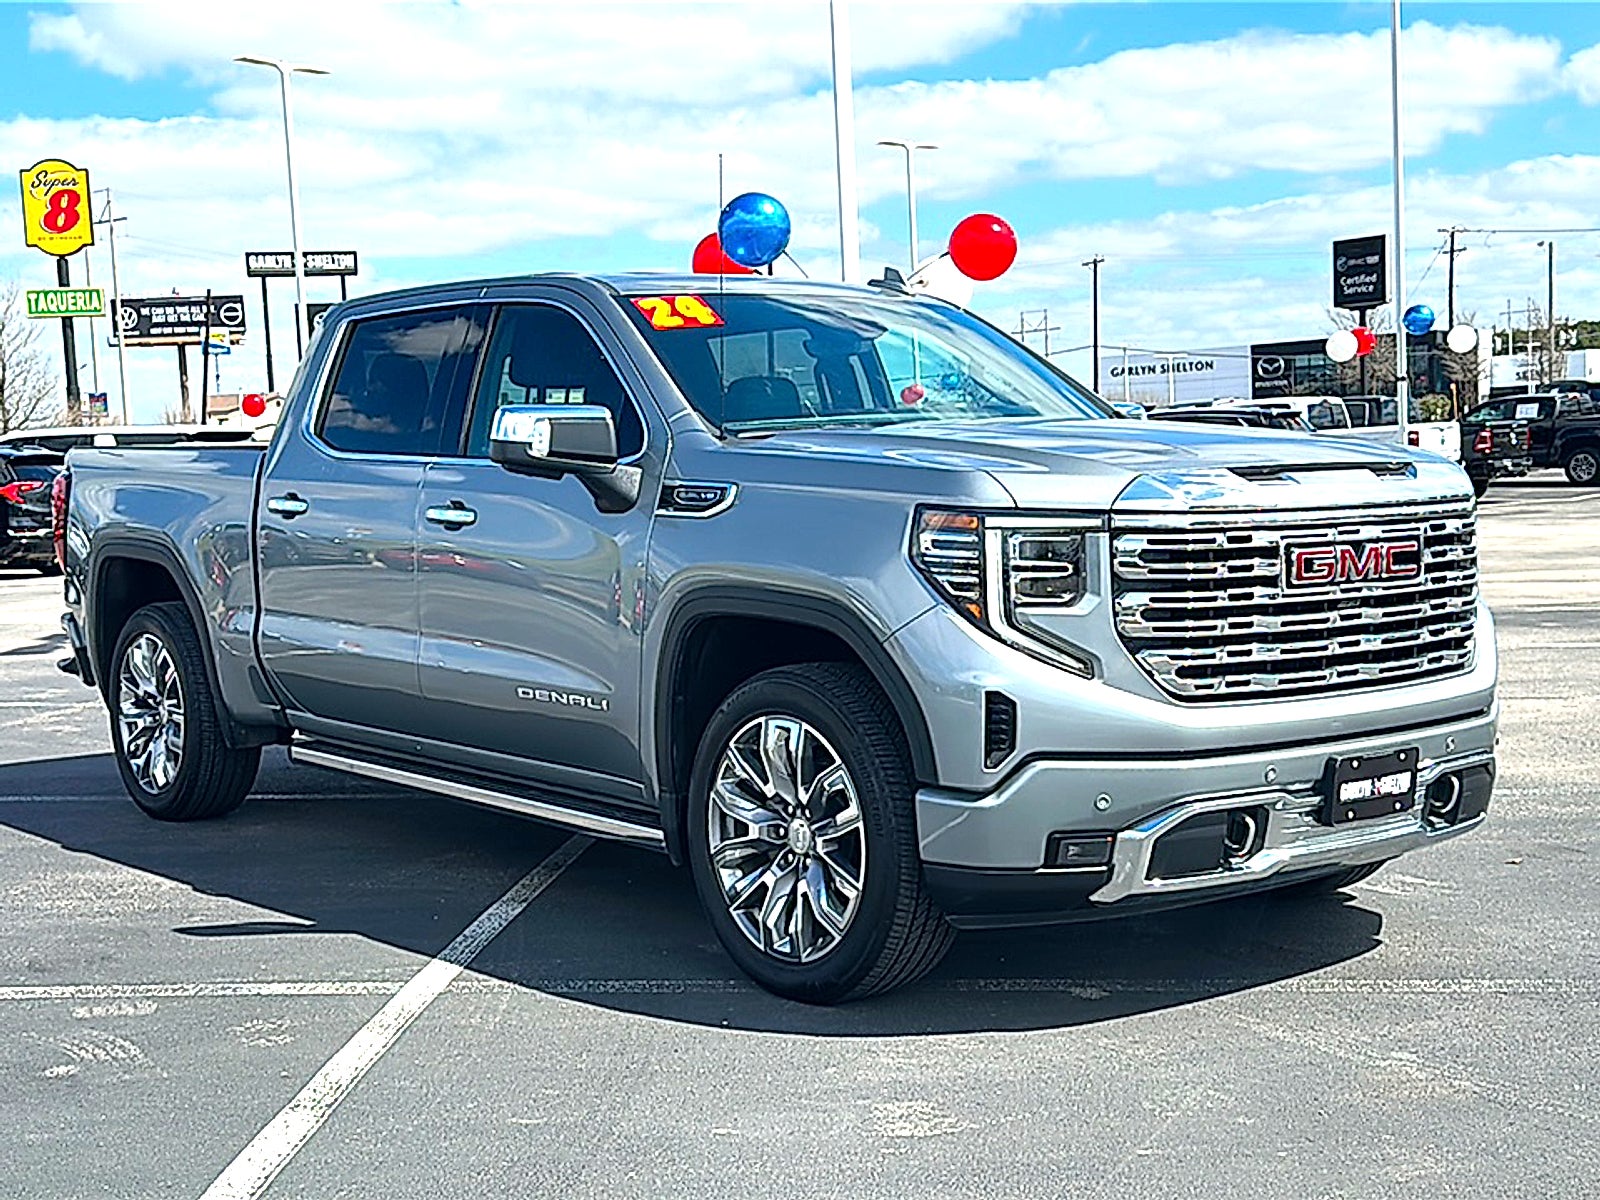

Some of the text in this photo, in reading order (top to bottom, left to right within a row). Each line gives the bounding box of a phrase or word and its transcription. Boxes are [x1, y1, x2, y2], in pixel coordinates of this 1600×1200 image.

[31, 170, 79, 196] Super
[41, 189, 81, 233] 8
[1340, 273, 1377, 286] Certified
[1343, 284, 1374, 294] Service
[27, 291, 102, 313] TAQUERIA
[1110, 360, 1214, 377] GARLYN SHELTON
[1291, 541, 1418, 584] GMC
[516, 687, 608, 711] DENALI
